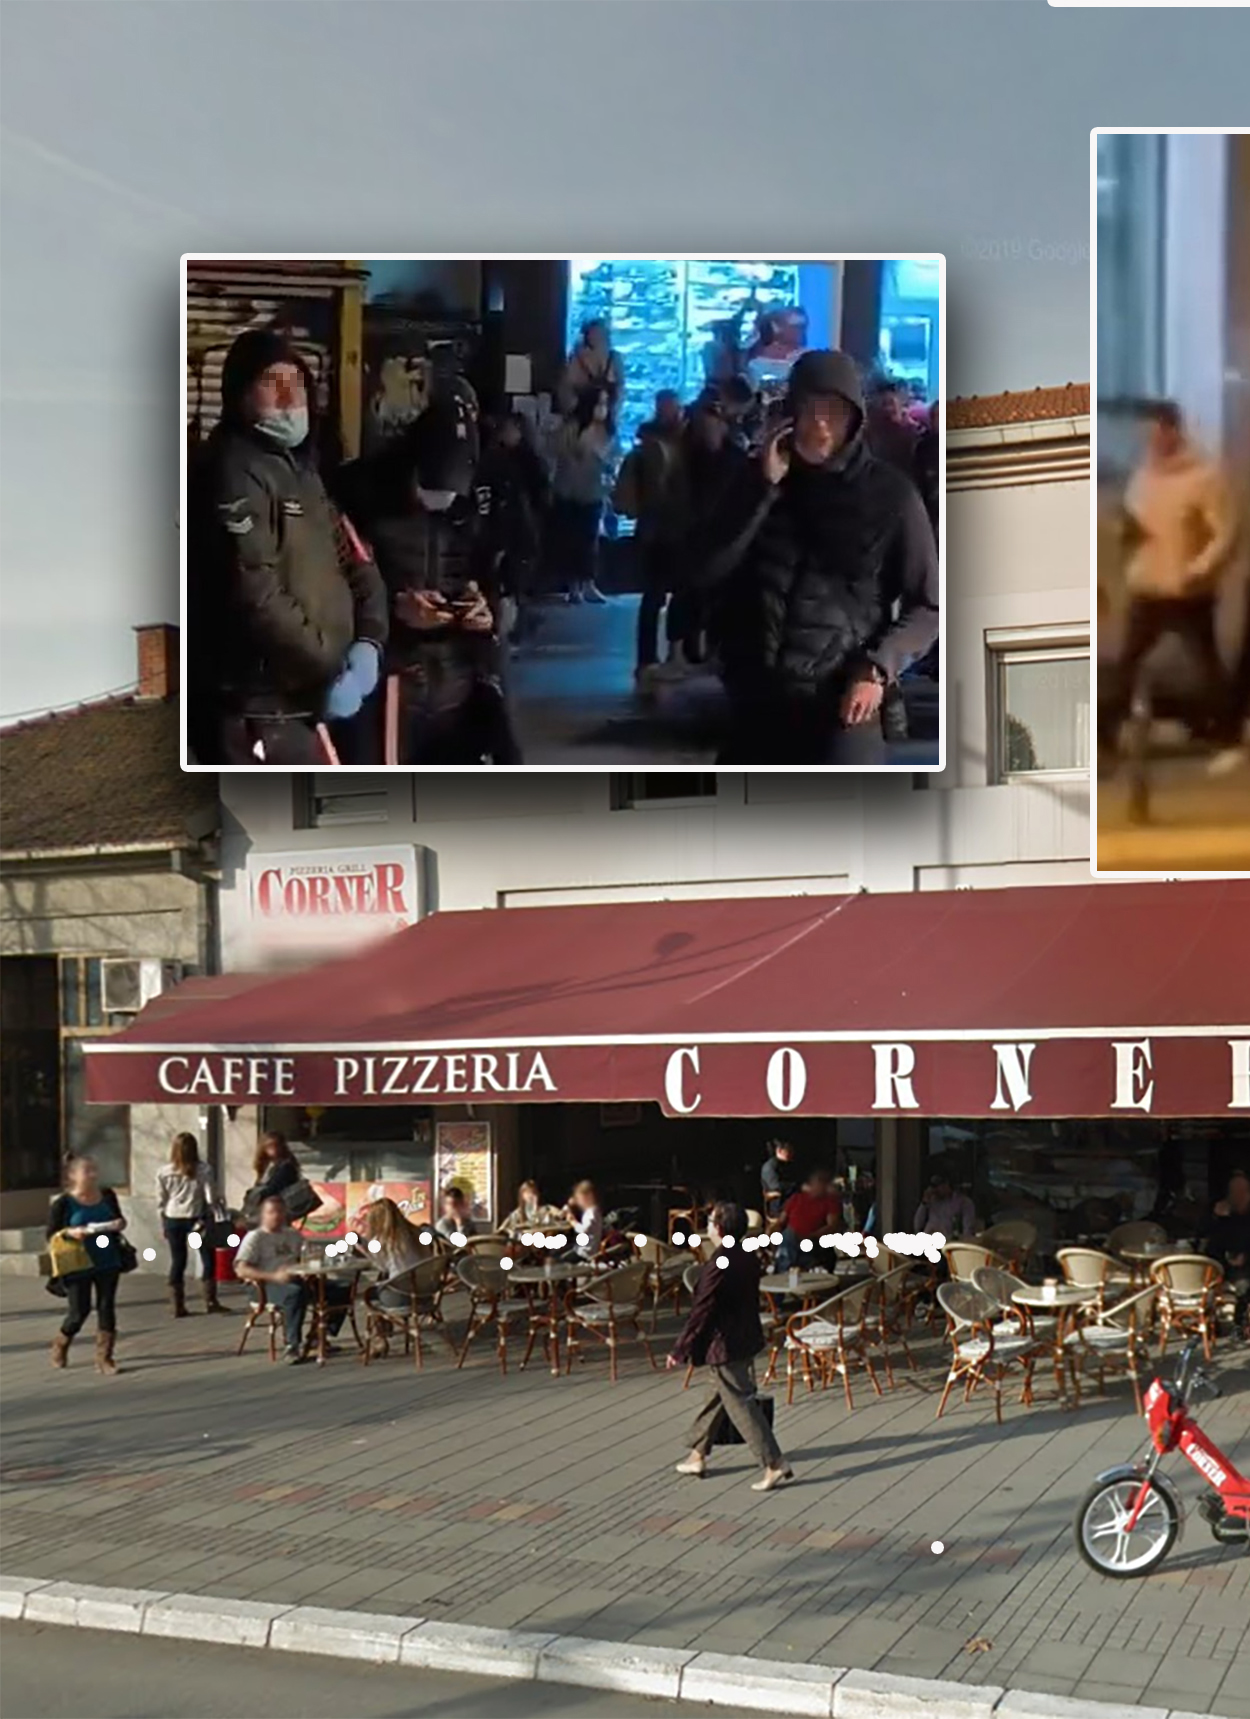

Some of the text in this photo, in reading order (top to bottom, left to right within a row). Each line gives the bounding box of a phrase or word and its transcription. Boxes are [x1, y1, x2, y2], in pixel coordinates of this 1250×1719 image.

[258, 863, 409, 918] CORNER
[289, 864, 367, 875] PIZZERIA GRILL
[158, 1051, 557, 1095] CAFFE PIZZERIA
